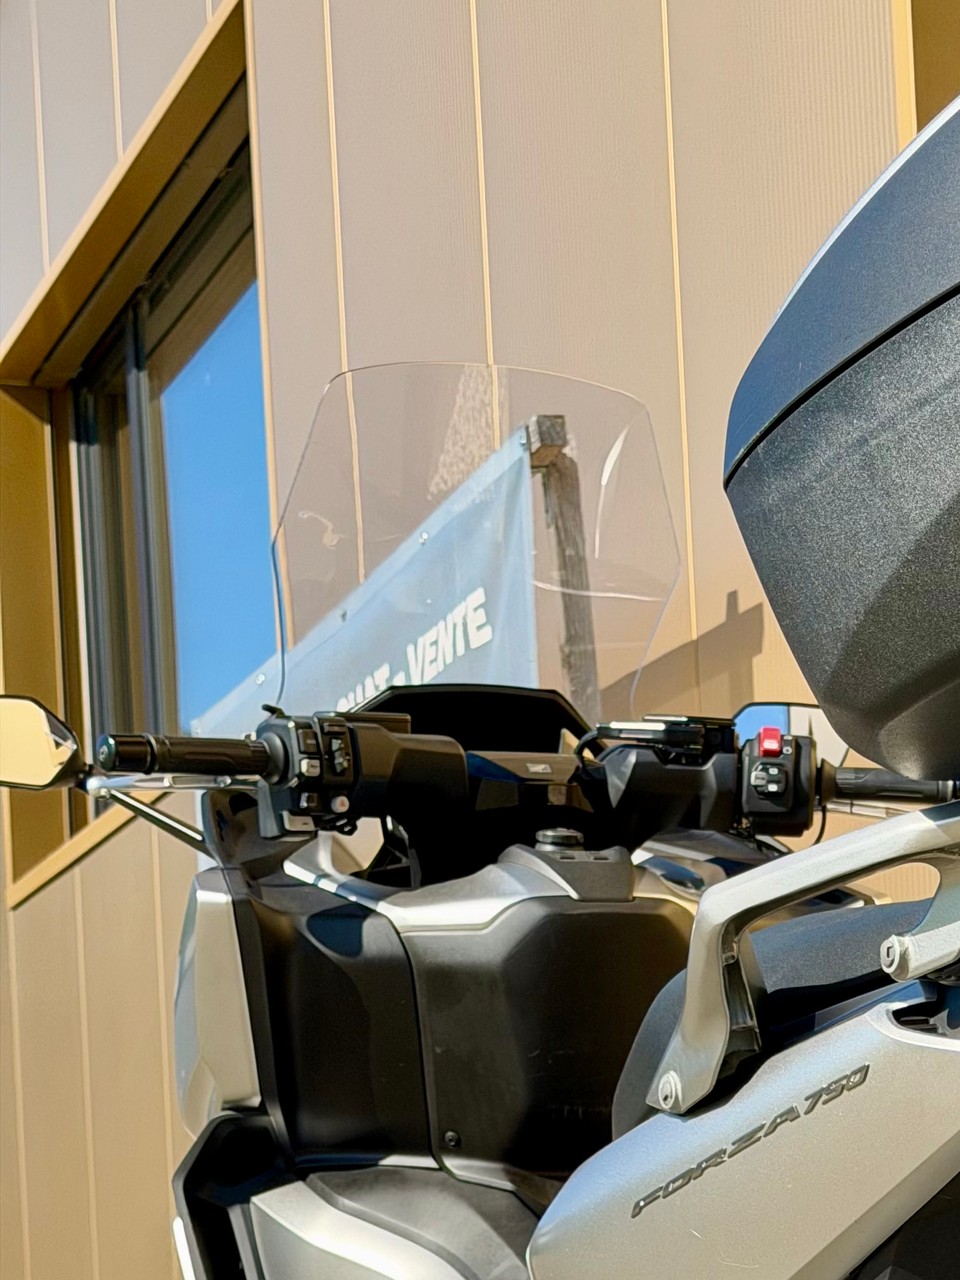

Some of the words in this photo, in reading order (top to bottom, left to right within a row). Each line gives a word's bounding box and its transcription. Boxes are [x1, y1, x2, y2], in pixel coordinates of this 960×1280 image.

[406, 586, 493, 685] VENTE
[631, 1104, 801, 1219] FORZA
[804, 1063, 870, 1115] 750
